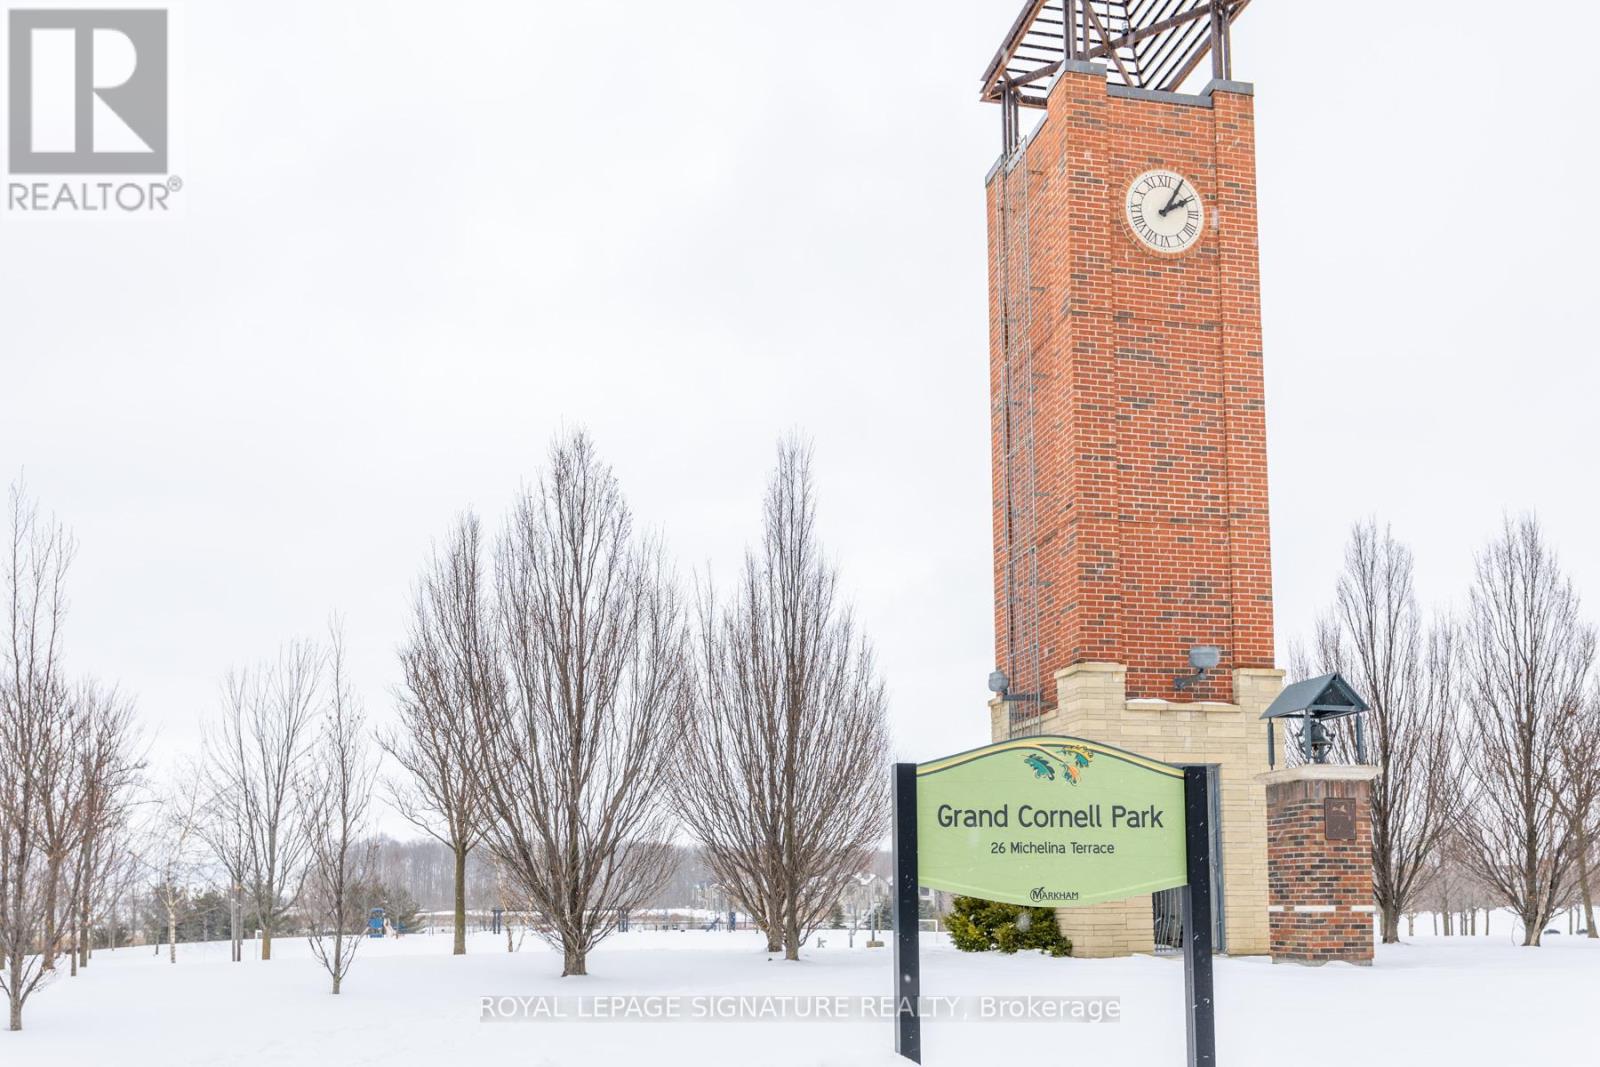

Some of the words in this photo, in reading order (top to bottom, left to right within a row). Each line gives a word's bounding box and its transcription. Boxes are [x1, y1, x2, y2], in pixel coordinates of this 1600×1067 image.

[937, 804, 1008, 828] Grand
[1018, 804, 1102, 828] Cornell
[1112, 805, 1164, 828] Park
[991, 842, 1006, 854] 26
[1010, 841, 1066, 854] Michelina
[1071, 842, 1115, 854] Terrace
[1030, 887, 1079, 902] MARKHAM
